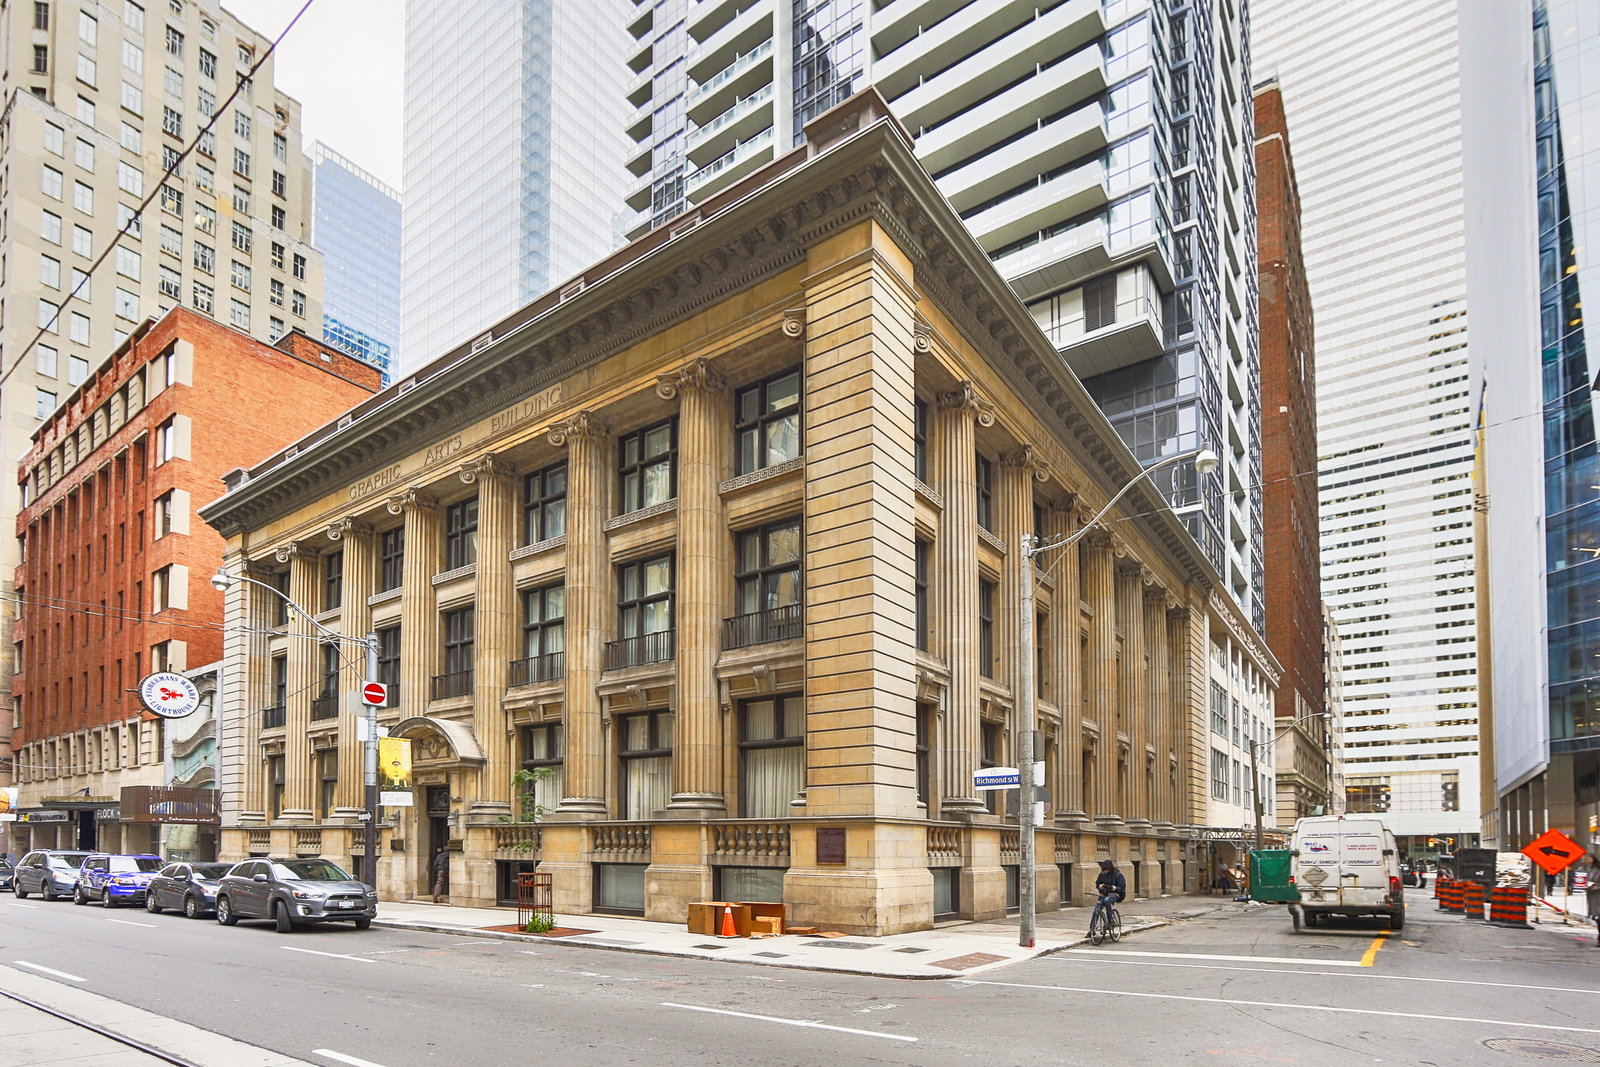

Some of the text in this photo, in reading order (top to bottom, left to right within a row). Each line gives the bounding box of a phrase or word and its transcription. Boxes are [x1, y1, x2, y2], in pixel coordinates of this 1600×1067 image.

[350, 387, 562, 499] GRAPHIC ARTS BUILDING
[146, 675, 196, 700] FISHERMANS WHARF
[150, 700, 193, 714] LIGHTHOUSE
[97, 808, 115, 819] FLOCK
